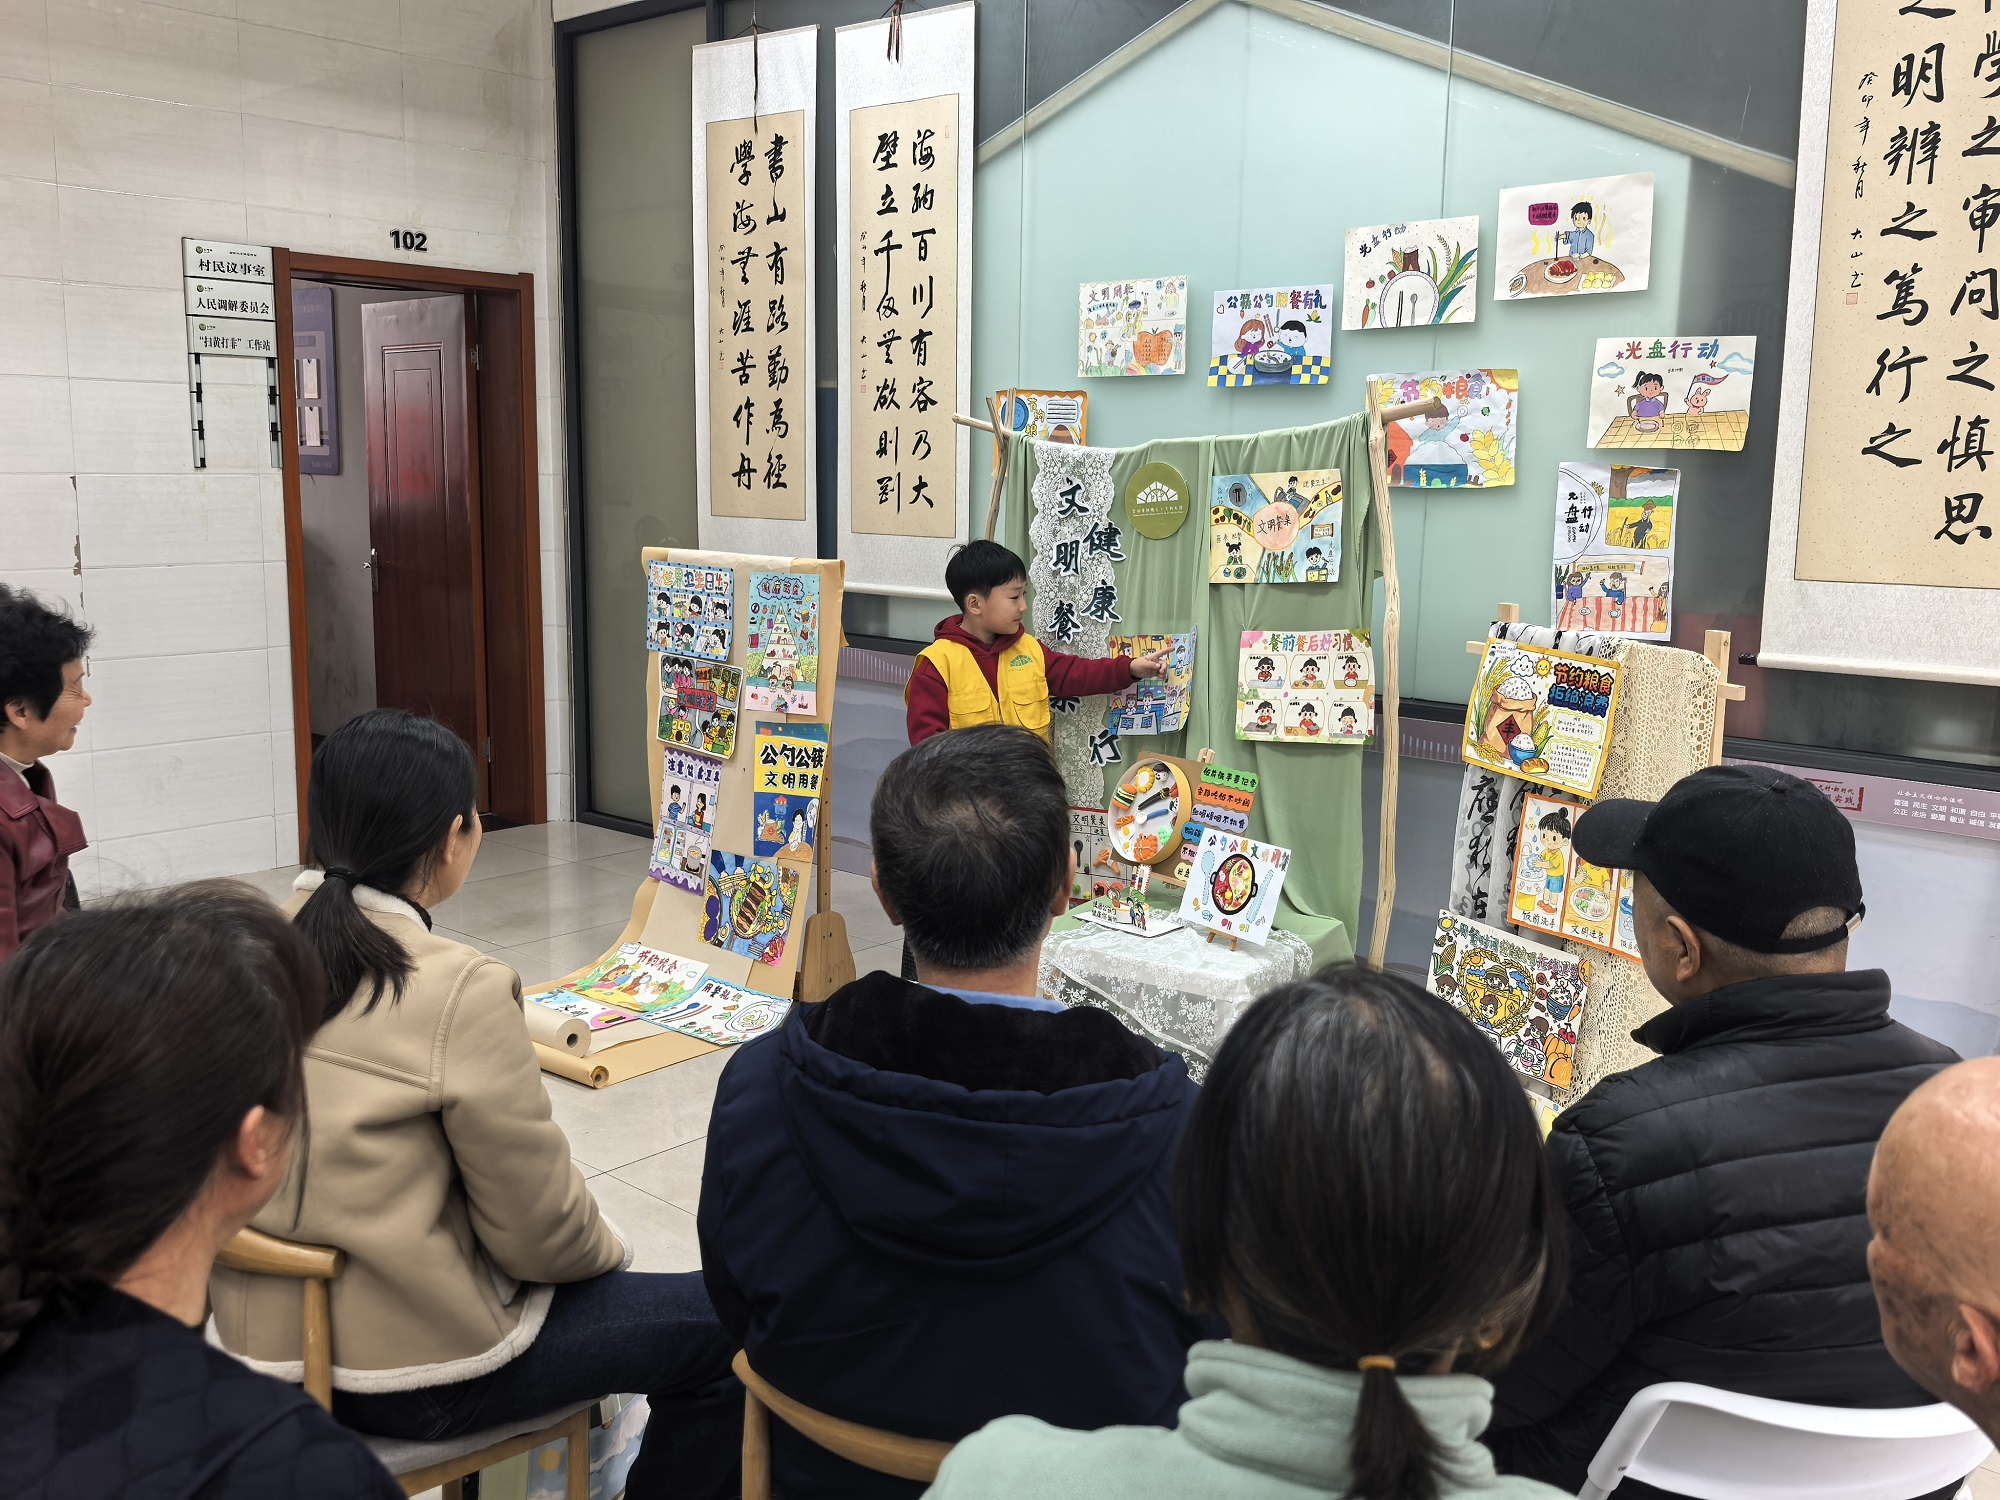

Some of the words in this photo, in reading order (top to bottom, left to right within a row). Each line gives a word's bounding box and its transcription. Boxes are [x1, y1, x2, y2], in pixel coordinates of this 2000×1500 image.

[390, 230, 428, 252] 102
[199, 258, 265, 277] 村民议事室
[196, 297, 270, 315] 人民调解委员会
[1625, 339, 1720, 360] 光盘行动
[1401, 373, 1487, 401] 节约粮食
[1257, 512, 1292, 535] 文明餐桌
[1269, 633, 1355, 653] 餐前餐后好习惯
[1553, 663, 1615, 696] 节约粮食
[1547, 683, 1610, 718] 拒绝浪费
[1503, 720, 1516, 739] 丰
[760, 743, 826, 769] 公勺公筷
[764, 771, 820, 790] 文明用餐
[1521, 910, 1556, 929] 饭前洗手
